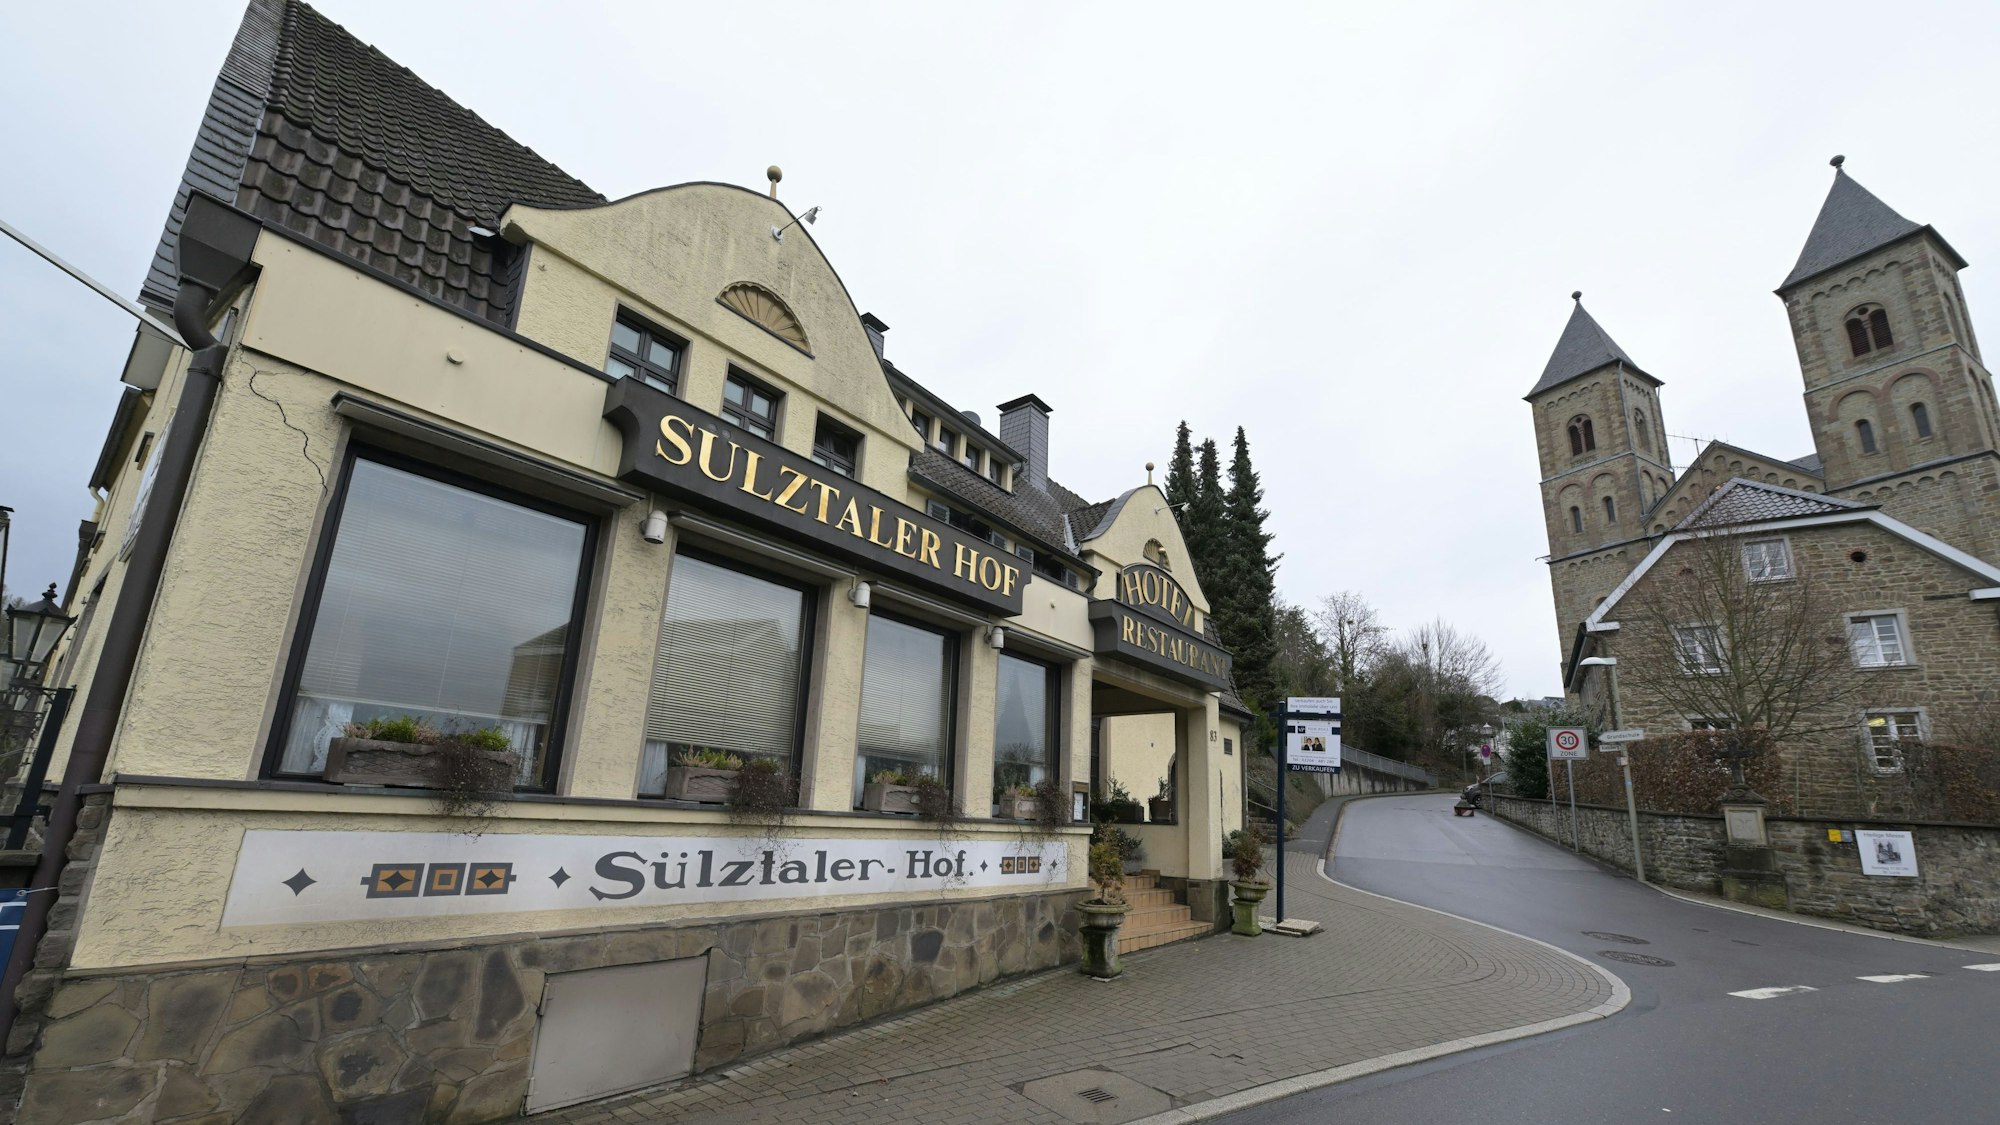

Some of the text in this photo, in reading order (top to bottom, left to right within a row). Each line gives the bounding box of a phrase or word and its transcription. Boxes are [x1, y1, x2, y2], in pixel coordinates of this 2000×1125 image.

[953, 542, 1020, 597] HOF
[1122, 615, 1227, 680] RESTAURANT
[1209, 729, 1218, 743] 83
[1560, 736, 1575, 746] 30
[1606, 732, 1640, 740] Grundschule
[1301, 765, 1335, 773] VERKAUFEN
